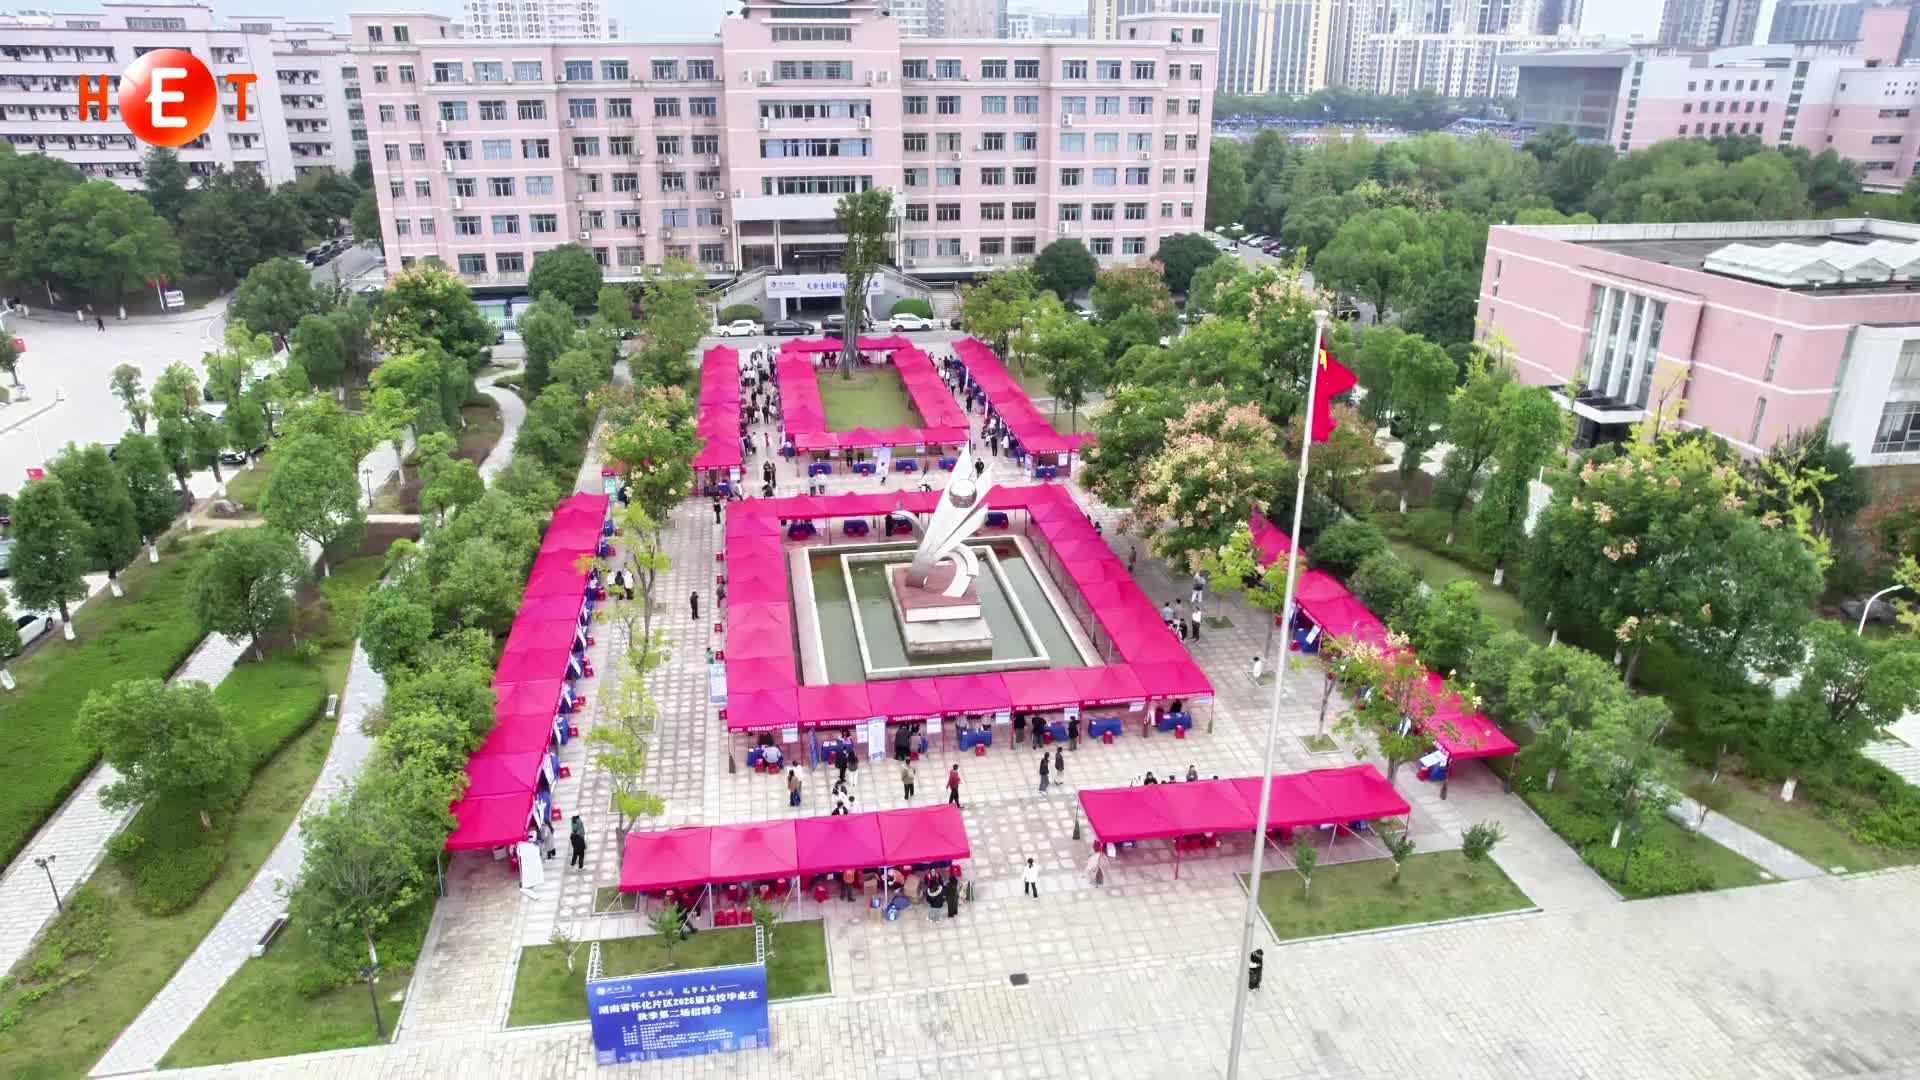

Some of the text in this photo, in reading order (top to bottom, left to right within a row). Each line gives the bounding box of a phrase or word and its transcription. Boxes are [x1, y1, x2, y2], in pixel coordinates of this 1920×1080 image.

[637, 1004, 723, 1022] 秋季第二场招聘会
